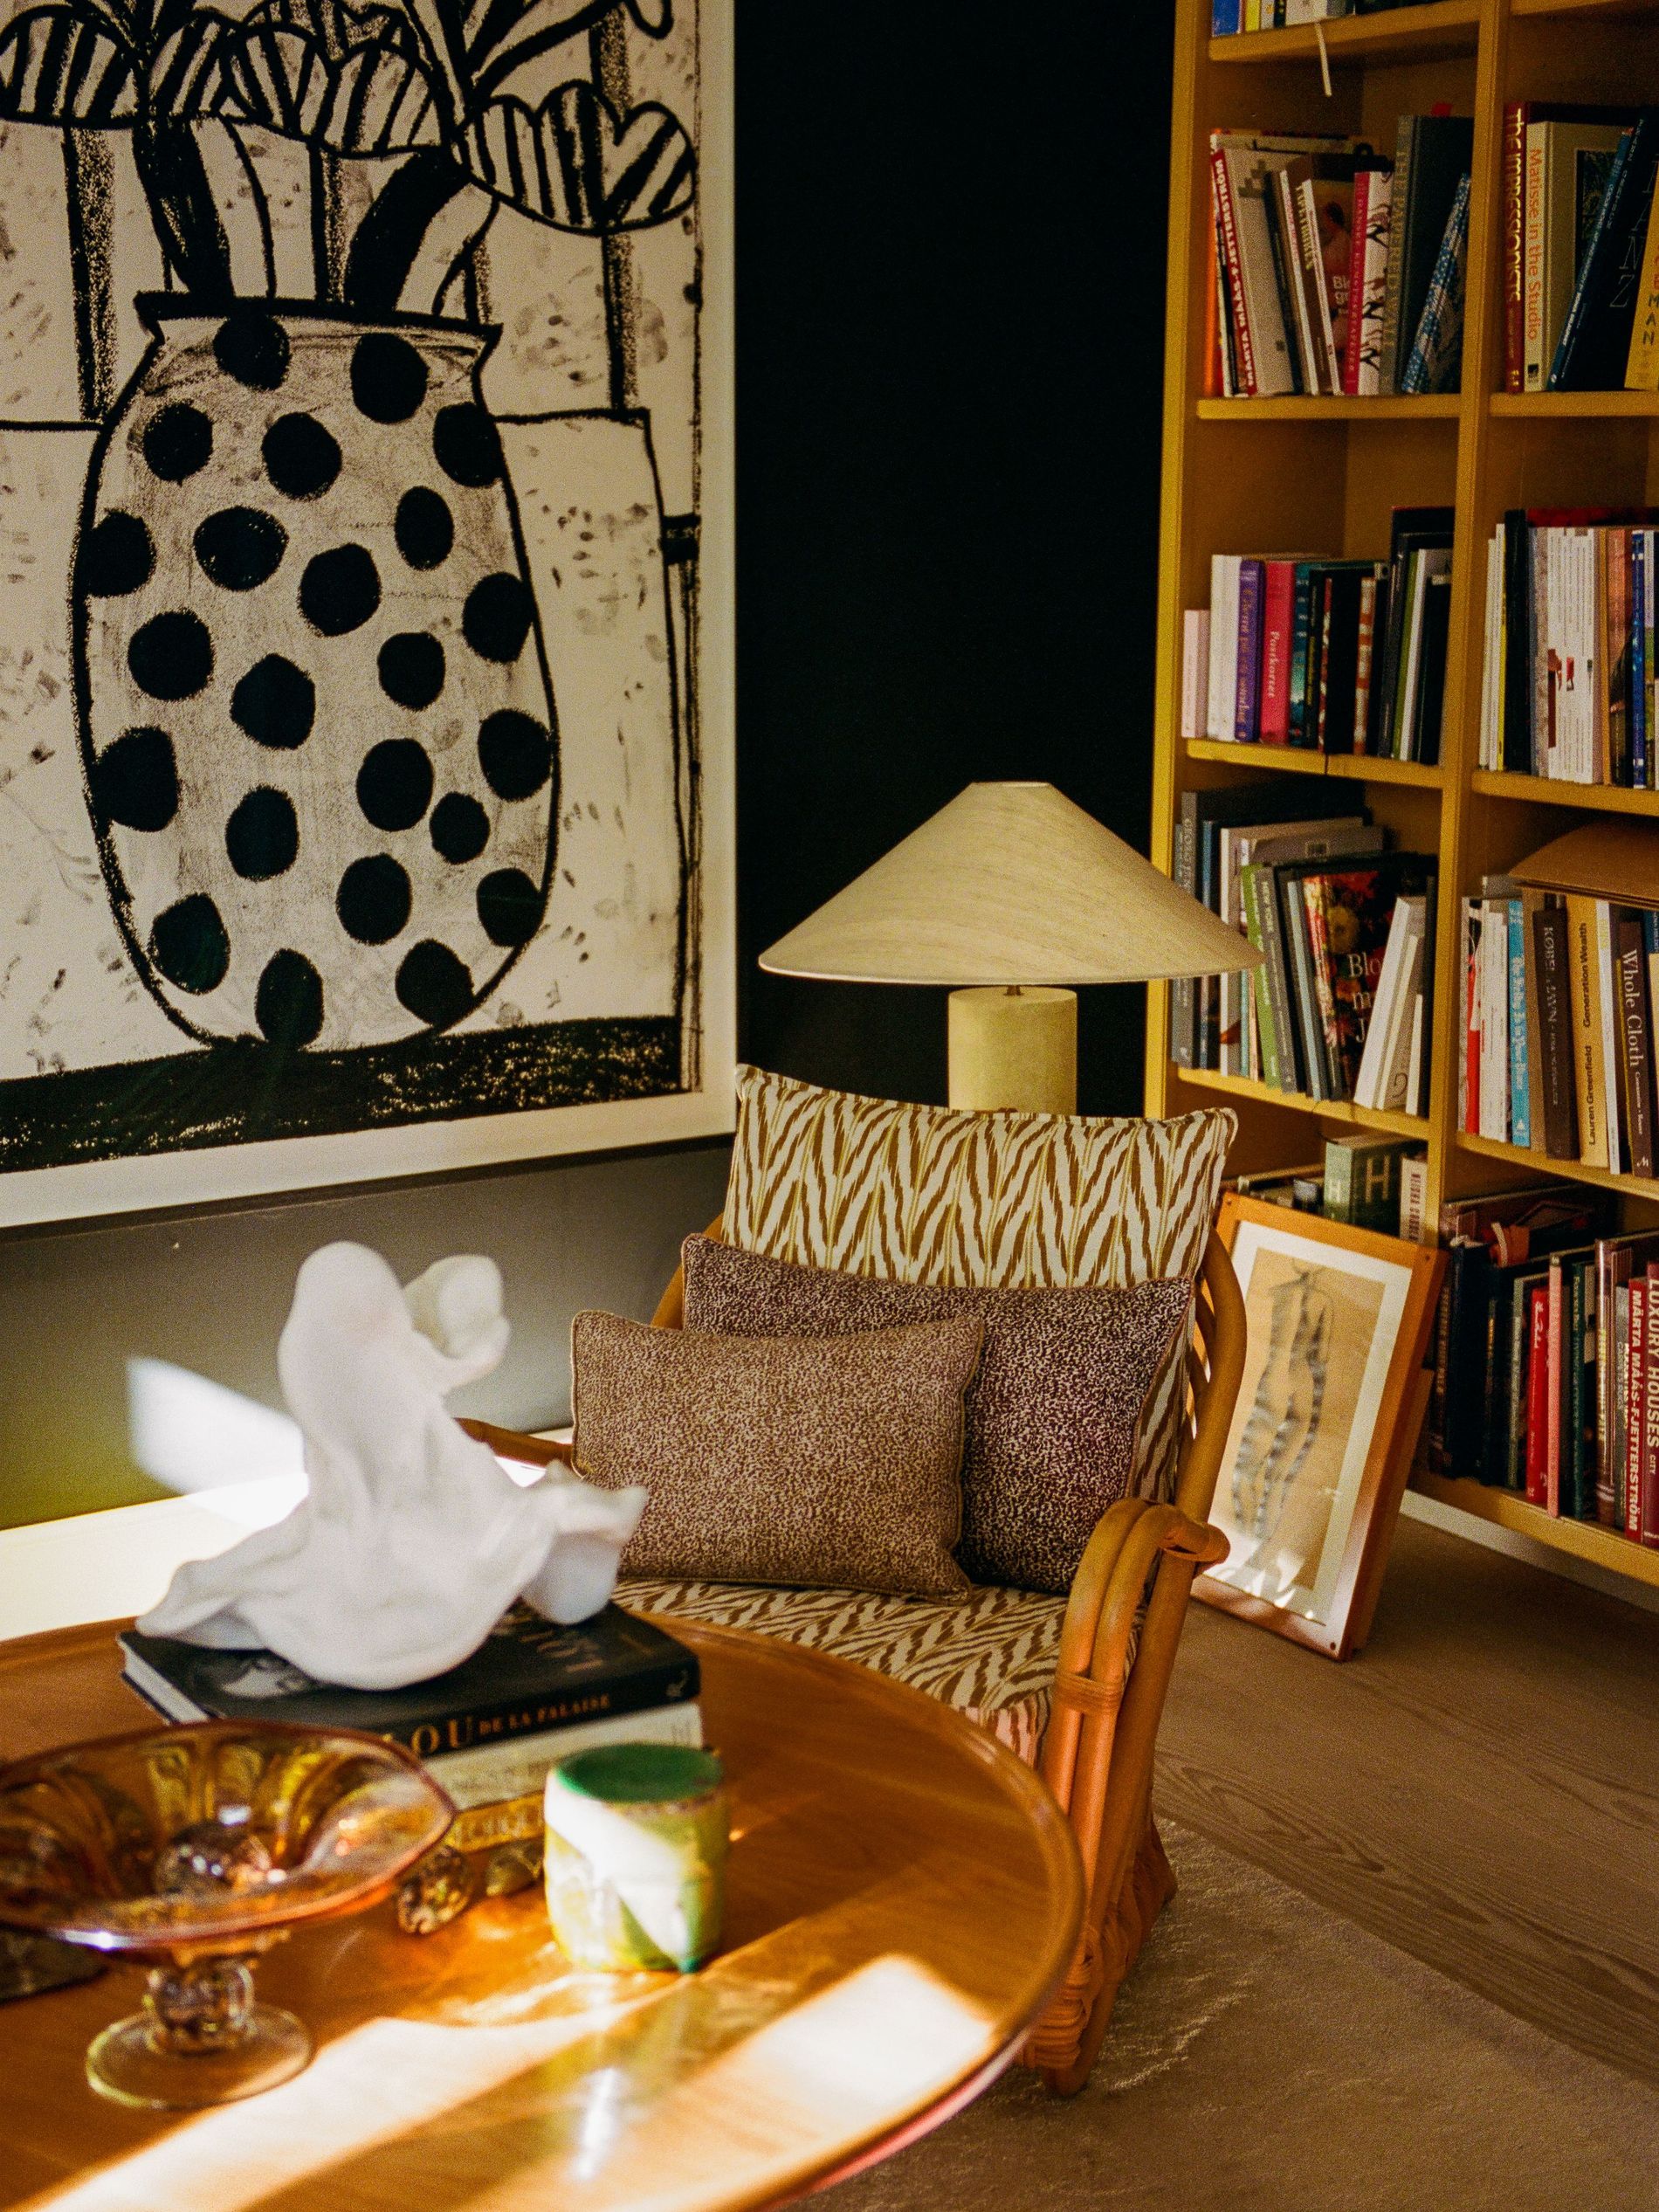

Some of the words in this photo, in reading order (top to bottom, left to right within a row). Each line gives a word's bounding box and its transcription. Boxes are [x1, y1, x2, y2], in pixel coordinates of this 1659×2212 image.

[1529, 148, 1542, 217] Matisse
[1528, 248, 1541, 274] the
[1530, 224, 1541, 240] in
[1527, 281, 1541, 341] Studio
[1578, 922, 1588, 962] Wealth
[1580, 964, 1591, 1027] Generation
[1621, 948, 1641, 1008] Whole
[1626, 1014, 1644, 1067] Cloth
[1584, 1044, 1594, 1104] Greenfield
[1587, 1106, 1596, 1145] Lauren
[1365, 1155, 1390, 1203] H
[1631, 1290, 1642, 1347] MÄRTA
[1648, 1278, 1659, 1357] LUXURY
[1647, 1366, 1659, 1447] HOUSES
[1628, 1353, 1642, 1530] MÅÅS-FJETTERSTRÖM
[509, 1711, 532, 1728] LA
[536, 1693, 611, 1724] FALAISE
